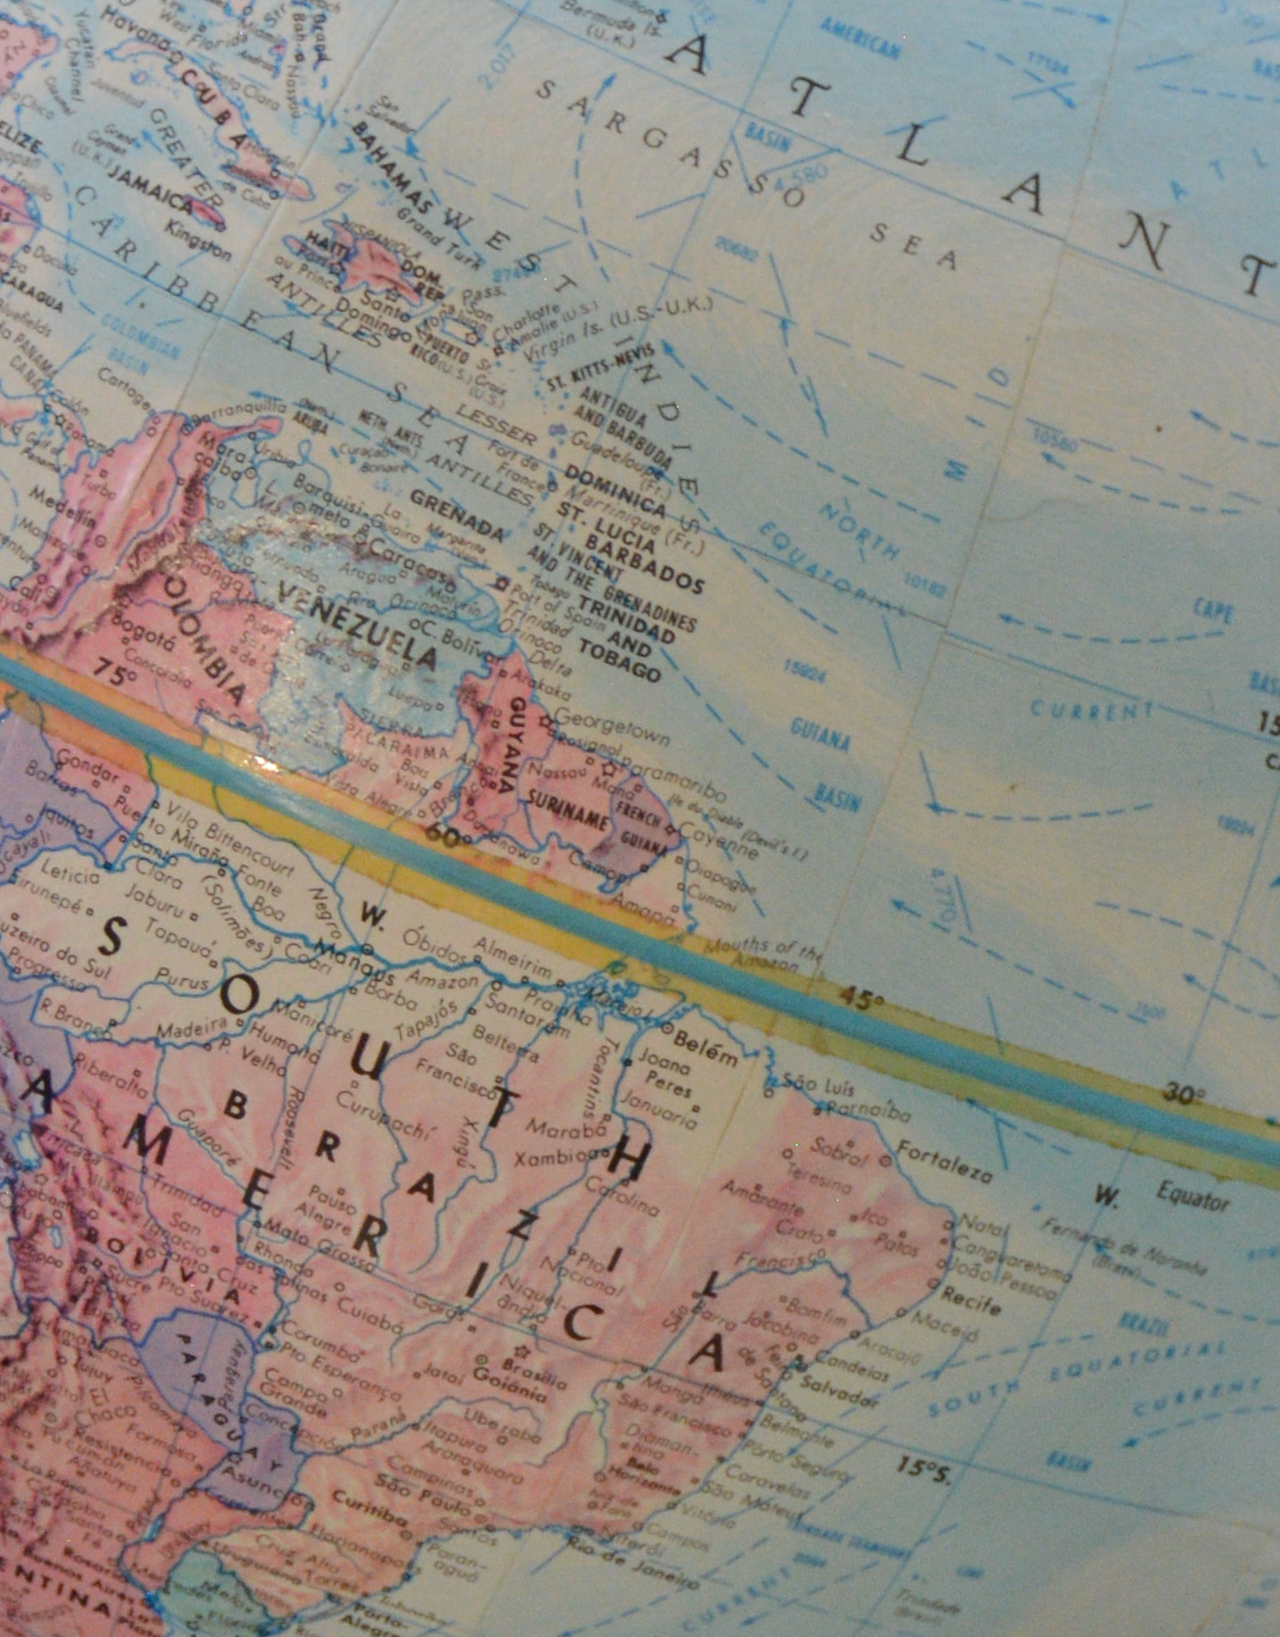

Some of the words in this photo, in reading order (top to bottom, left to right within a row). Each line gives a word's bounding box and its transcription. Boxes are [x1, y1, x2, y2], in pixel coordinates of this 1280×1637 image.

[149, 107, 226, 208] GREATER
[107, 164, 195, 217] JAMAICA
[163, 219, 233, 263] Kingston
[266, 271, 383, 350] ANTILLES
[455, 403, 539, 447] LESSER
[579, 385, 648, 429] ANTIGUA
[605, 417, 673, 471] BARBUDA
[563, 463, 667, 519] DOMINICA
[409, 488, 506, 544] GRENADA
[591, 518, 658, 555] LUCIA
[584, 534, 707, 597] BARBADOS
[579, 594, 677, 646] TRINIDAD
[577, 637, 662, 685] TOBAGO
[606, 630, 654, 659] AND
[92, 657, 138, 687] 75°
[498, 695, 529, 797] GUYANA
[790, 716, 853, 754] GUIANA
[527, 789, 612, 835] SURINAME
[814, 783, 863, 814] BASIN
[358, 900, 388, 932] W.
[839, 986, 885, 1012] 45°
[1161, 1080, 1207, 1106] 30°
[894, 1139, 995, 1187] Fortaleza
[1156, 1180, 1233, 1215] Equator
[940, 1284, 1005, 1318] Recife
